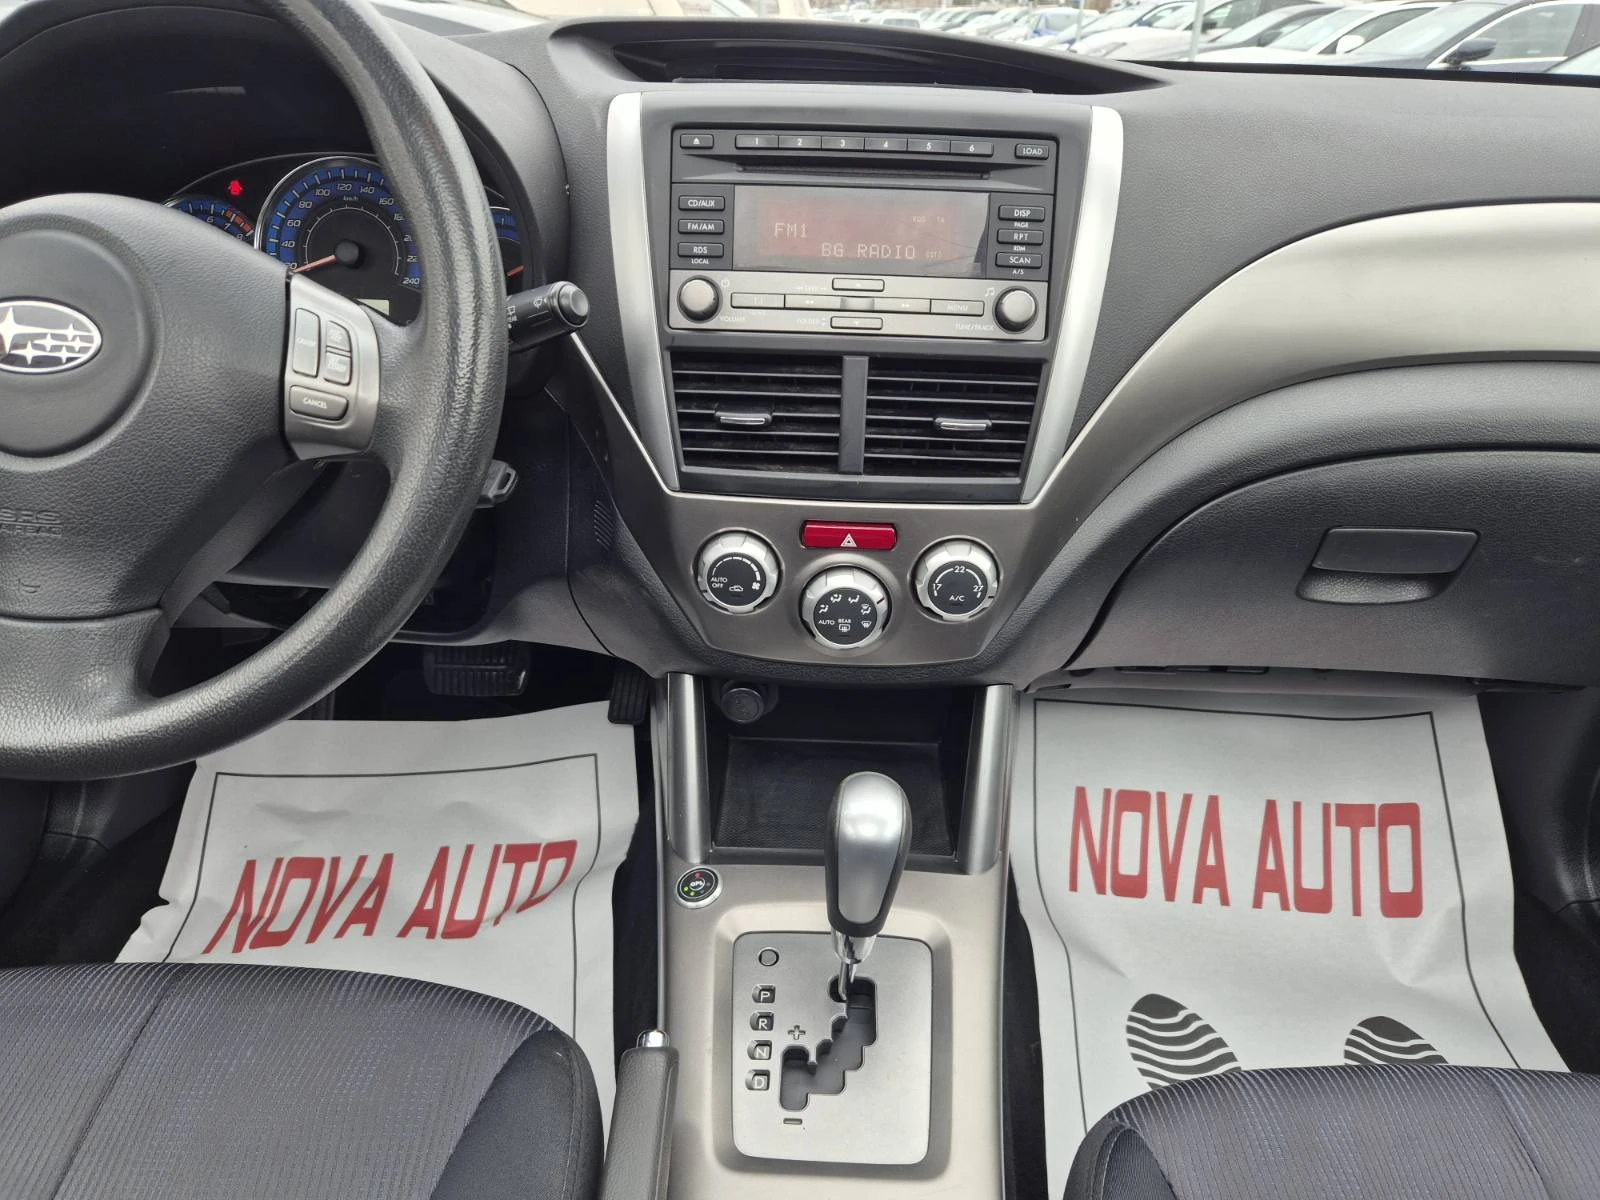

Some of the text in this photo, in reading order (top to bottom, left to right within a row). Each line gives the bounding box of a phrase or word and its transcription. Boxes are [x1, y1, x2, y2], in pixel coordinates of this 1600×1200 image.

[797, 138, 803, 146] 2
[840, 139, 846, 147] 3
[926, 142, 932, 150] 5
[969, 144, 975, 152] 6
[336, 183, 352, 191] 120
[360, 186, 375, 194] 140
[315, 188, 330, 196] 100
[298, 201, 312, 209] 80
[687, 199, 715, 207] CD/AUX
[1013, 209, 1031, 217] DISP
[287, 219, 300, 227] 60
[687, 223, 715, 231] FM/AM
[774, 222, 807, 238] FM1
[1013, 233, 1029, 241] RPT
[281, 240, 295, 248] 40
[693, 246, 708, 254] RDS
[821, 243, 916, 260] BG RADIO
[1008, 256, 1031, 264] SCAN
[402, 277, 420, 285] 240
[946, 303, 968, 312] MENU
[302, 396, 328, 409] CANCEL
[953, 565, 966, 573] 22
[933, 583, 943, 591] 17
[972, 584, 984, 592] 27
[1069, 786, 1423, 918] NOVA AUTO
[202, 839, 577, 954] NOVA AUTO
[760, 990, 770, 1001] P
[758, 1019, 768, 1029] R
[755, 1046, 769, 1058] N
[754, 1076, 765, 1087] D
